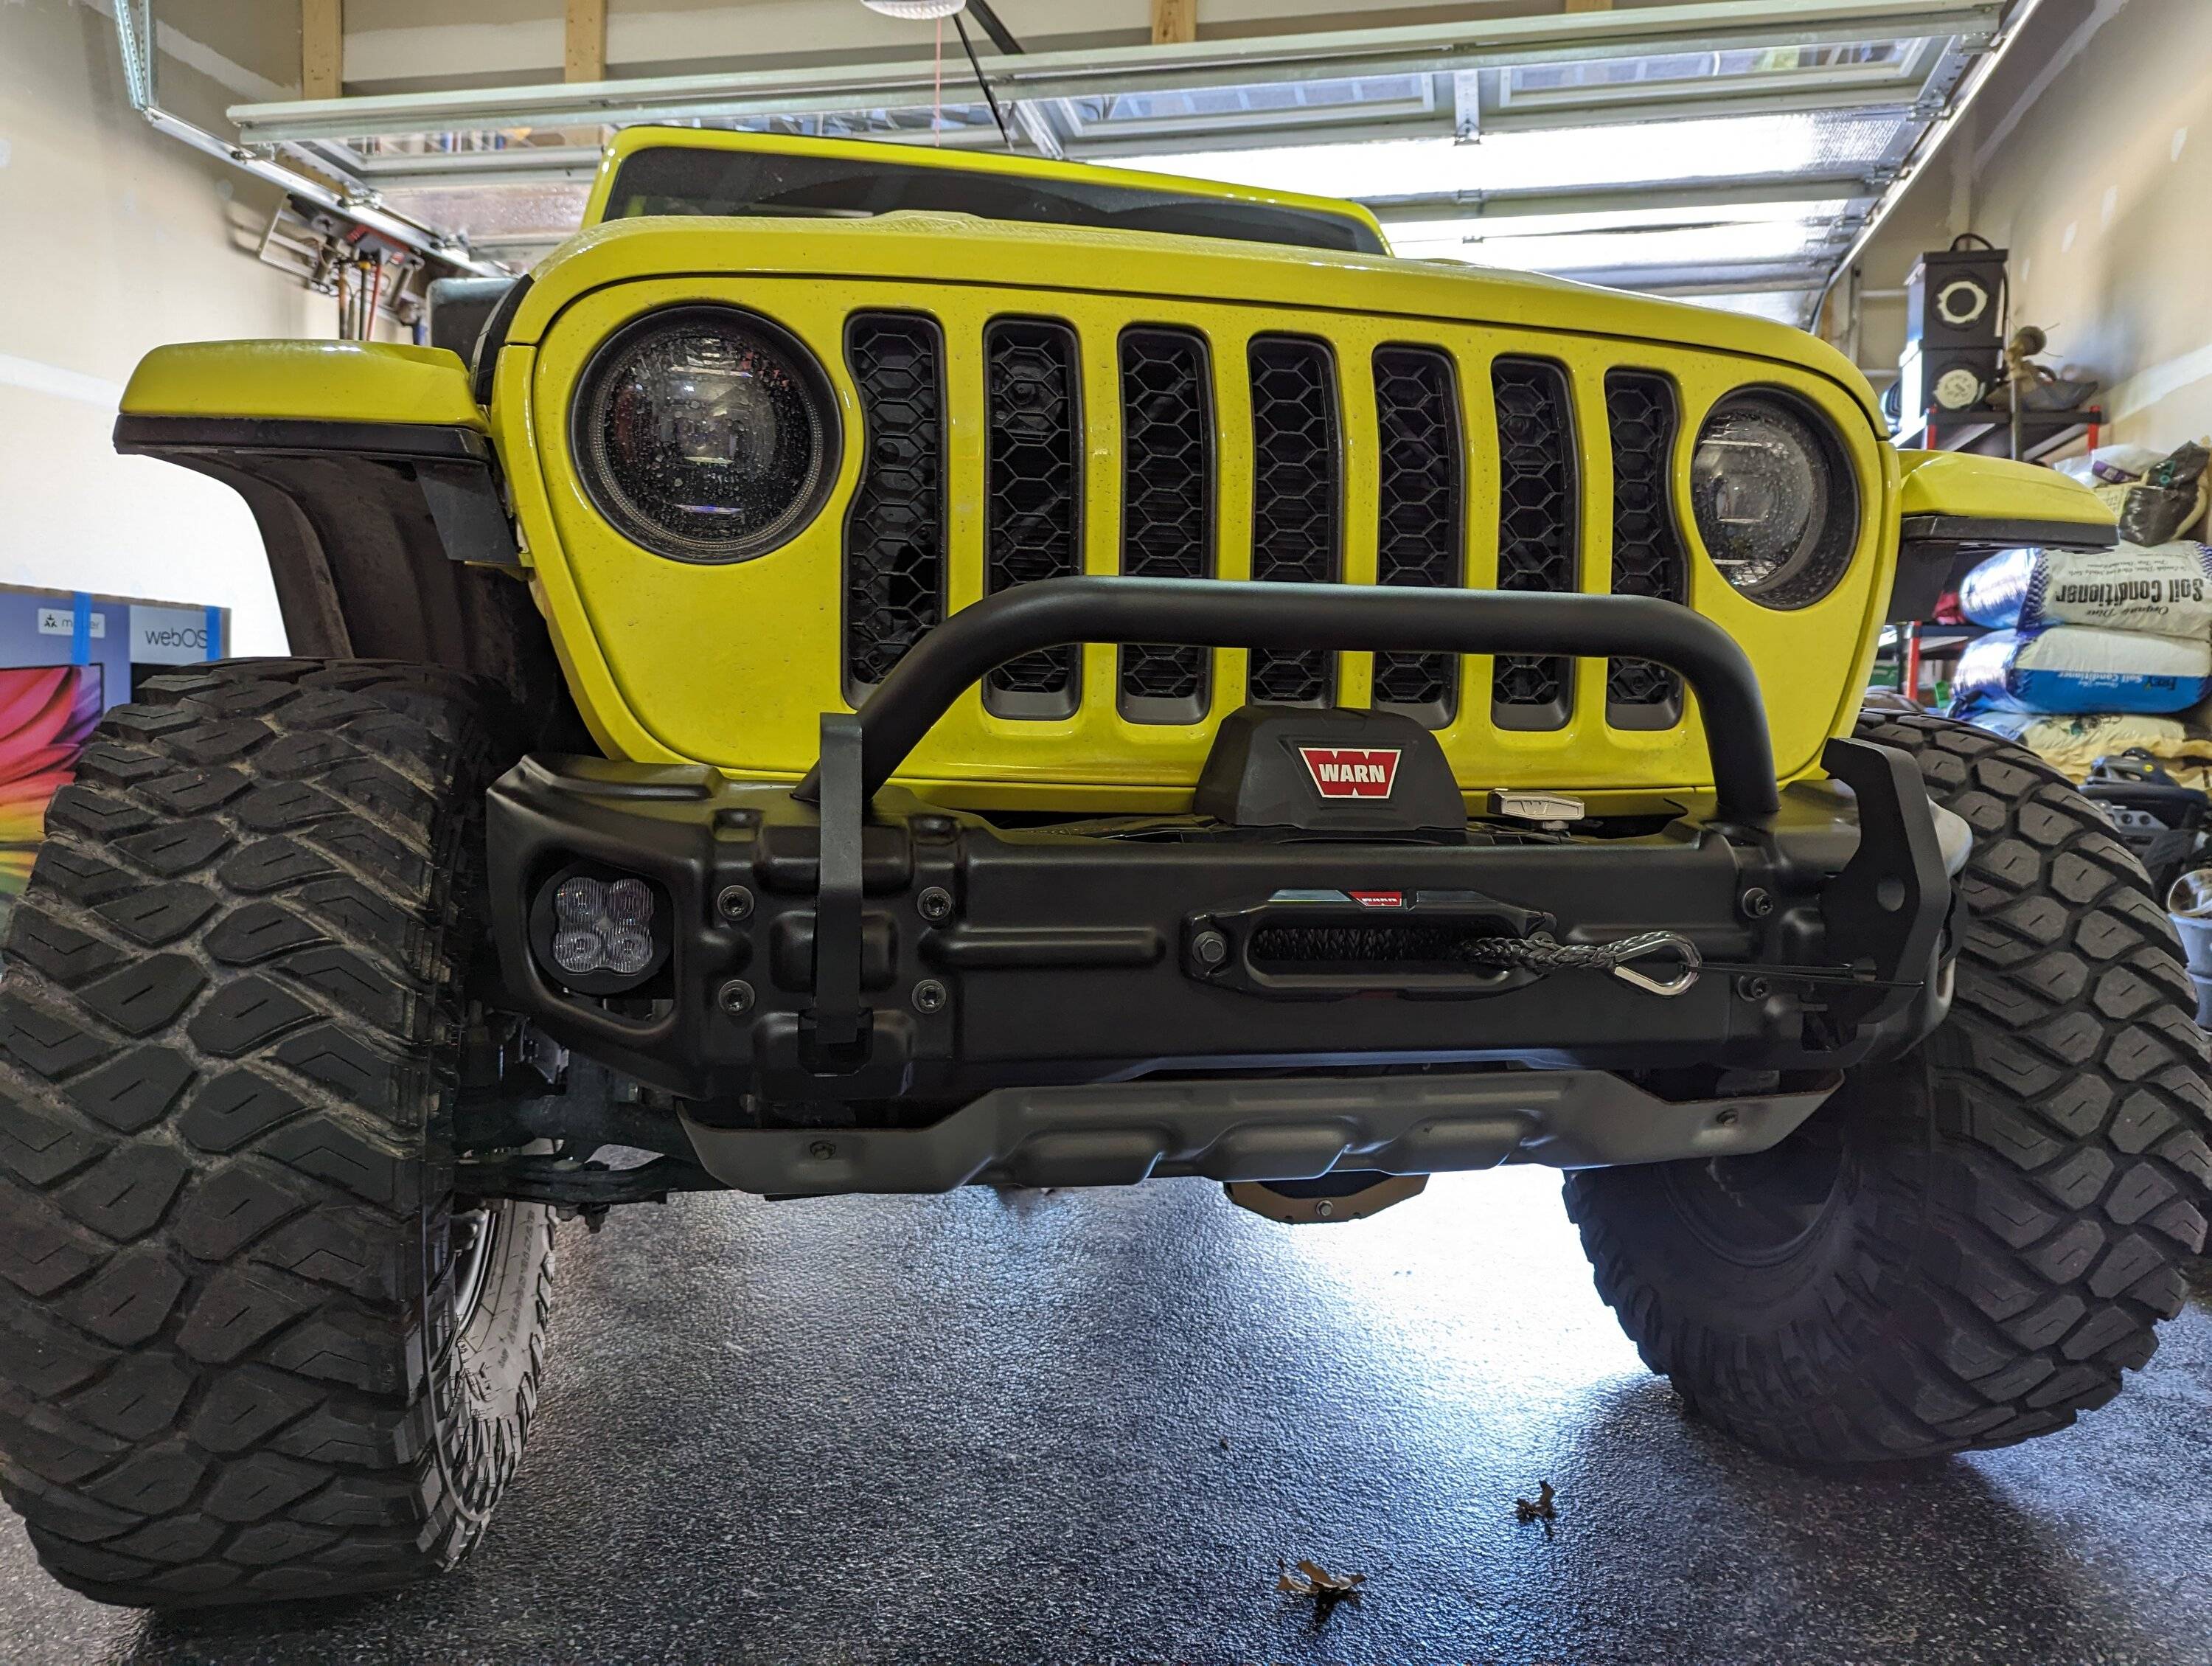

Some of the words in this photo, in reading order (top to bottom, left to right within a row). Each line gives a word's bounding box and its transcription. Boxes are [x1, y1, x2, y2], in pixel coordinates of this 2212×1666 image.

[2055, 579, 2163, 607] Conditioner
[2168, 577, 2204, 603] Soil
[145, 628, 209, 649] webOS
[1318, 764, 1386, 783] WARN
